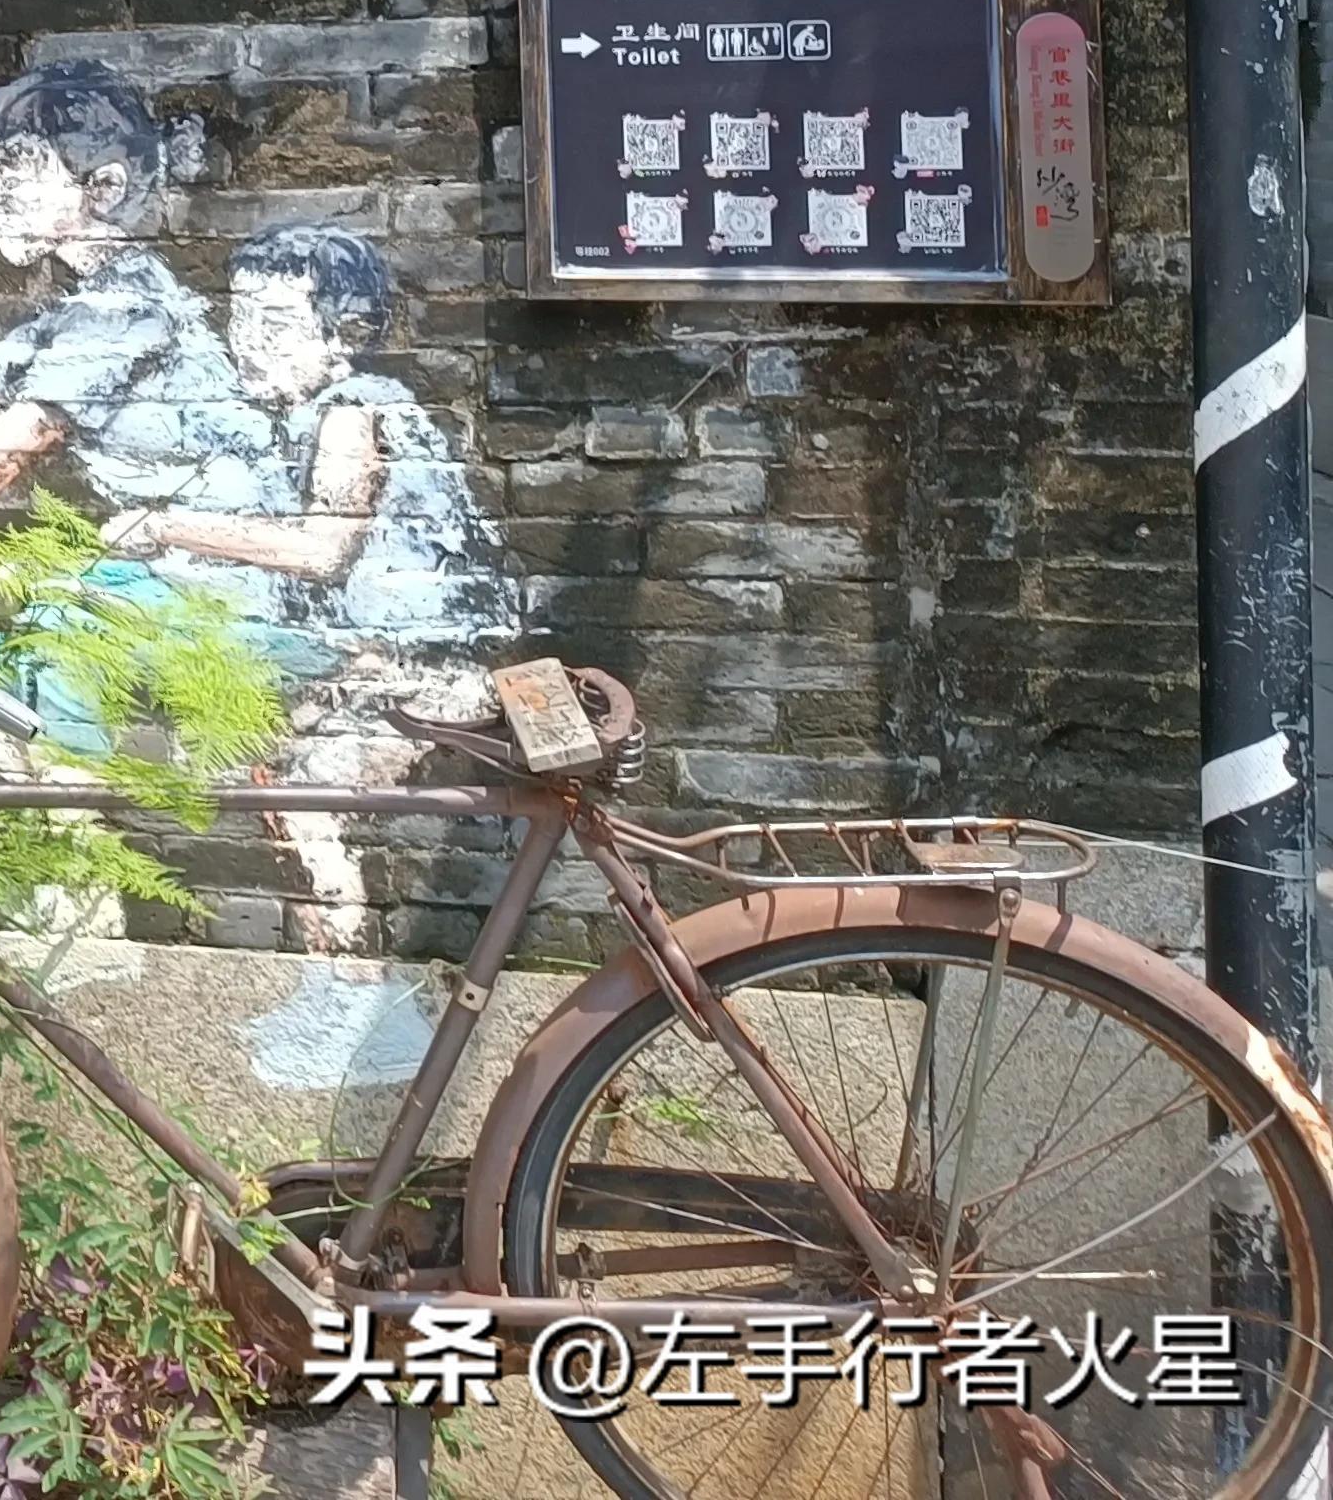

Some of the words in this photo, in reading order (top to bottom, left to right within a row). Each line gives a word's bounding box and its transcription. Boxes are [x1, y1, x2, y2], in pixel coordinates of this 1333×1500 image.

[611, 22, 701, 43] 卫生间
[612, 46, 680, 67] Toilet
